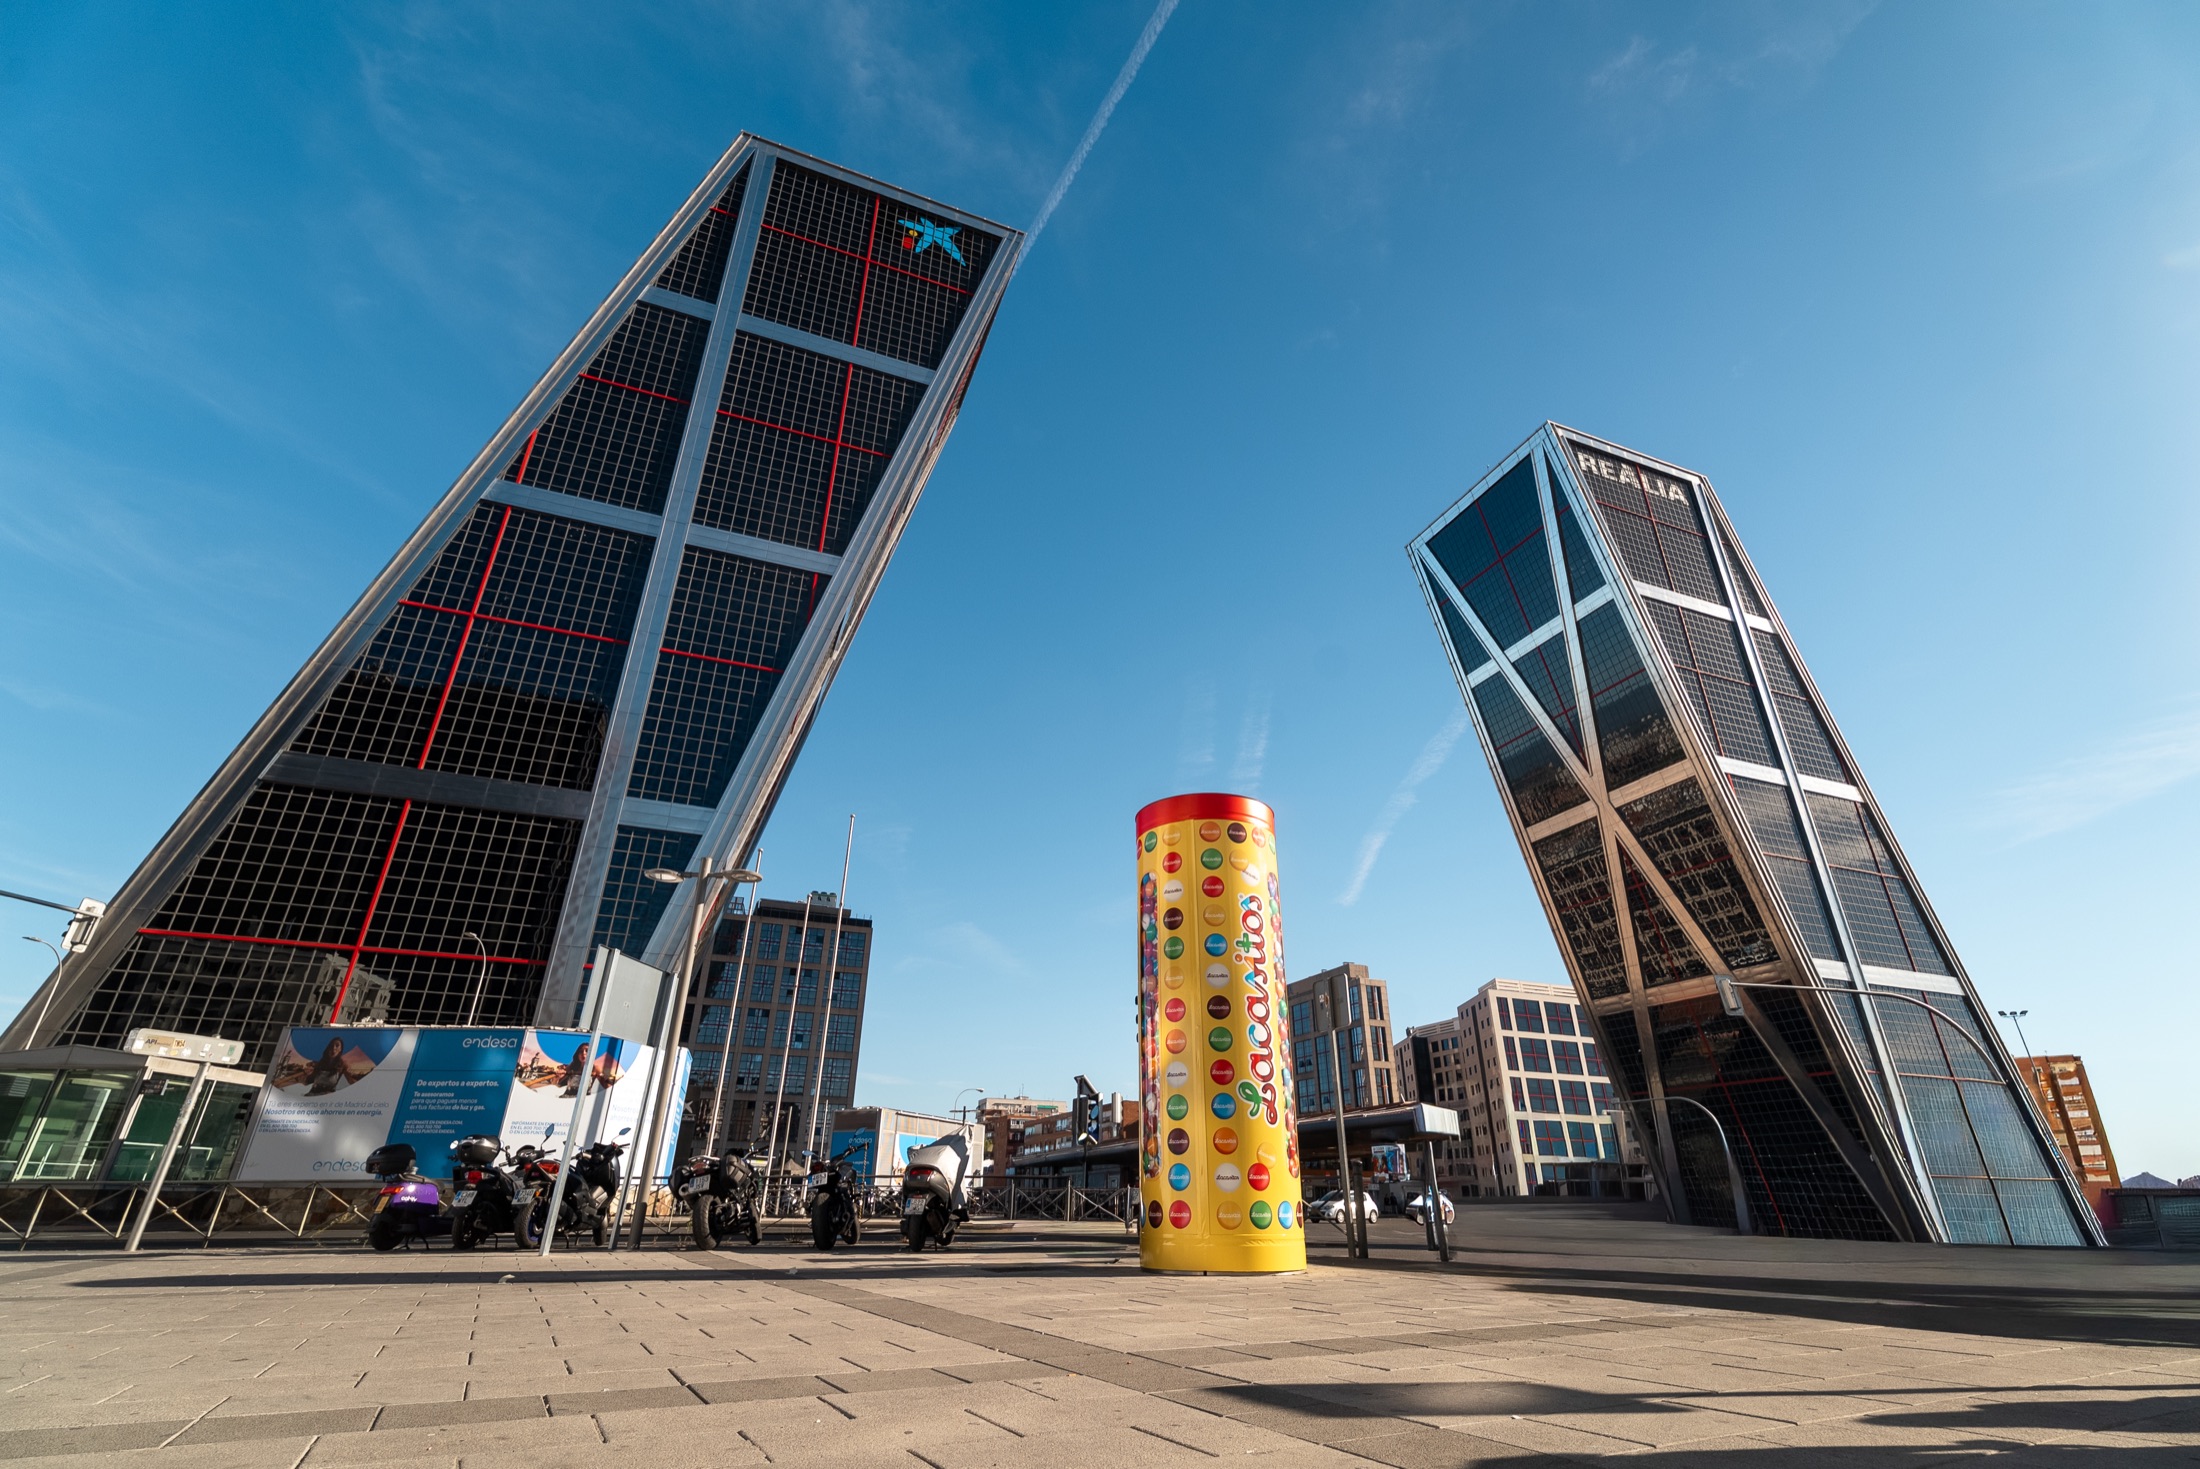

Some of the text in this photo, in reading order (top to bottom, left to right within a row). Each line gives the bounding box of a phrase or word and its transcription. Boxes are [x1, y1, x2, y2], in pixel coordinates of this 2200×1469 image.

[1577, 451, 1690, 507] REALIA
[1235, 894, 1278, 1126] Lacasitos
[463, 1035, 519, 1049] endesa
[428, 1080, 460, 1088] expertos
[466, 1080, 499, 1088] expertos.
